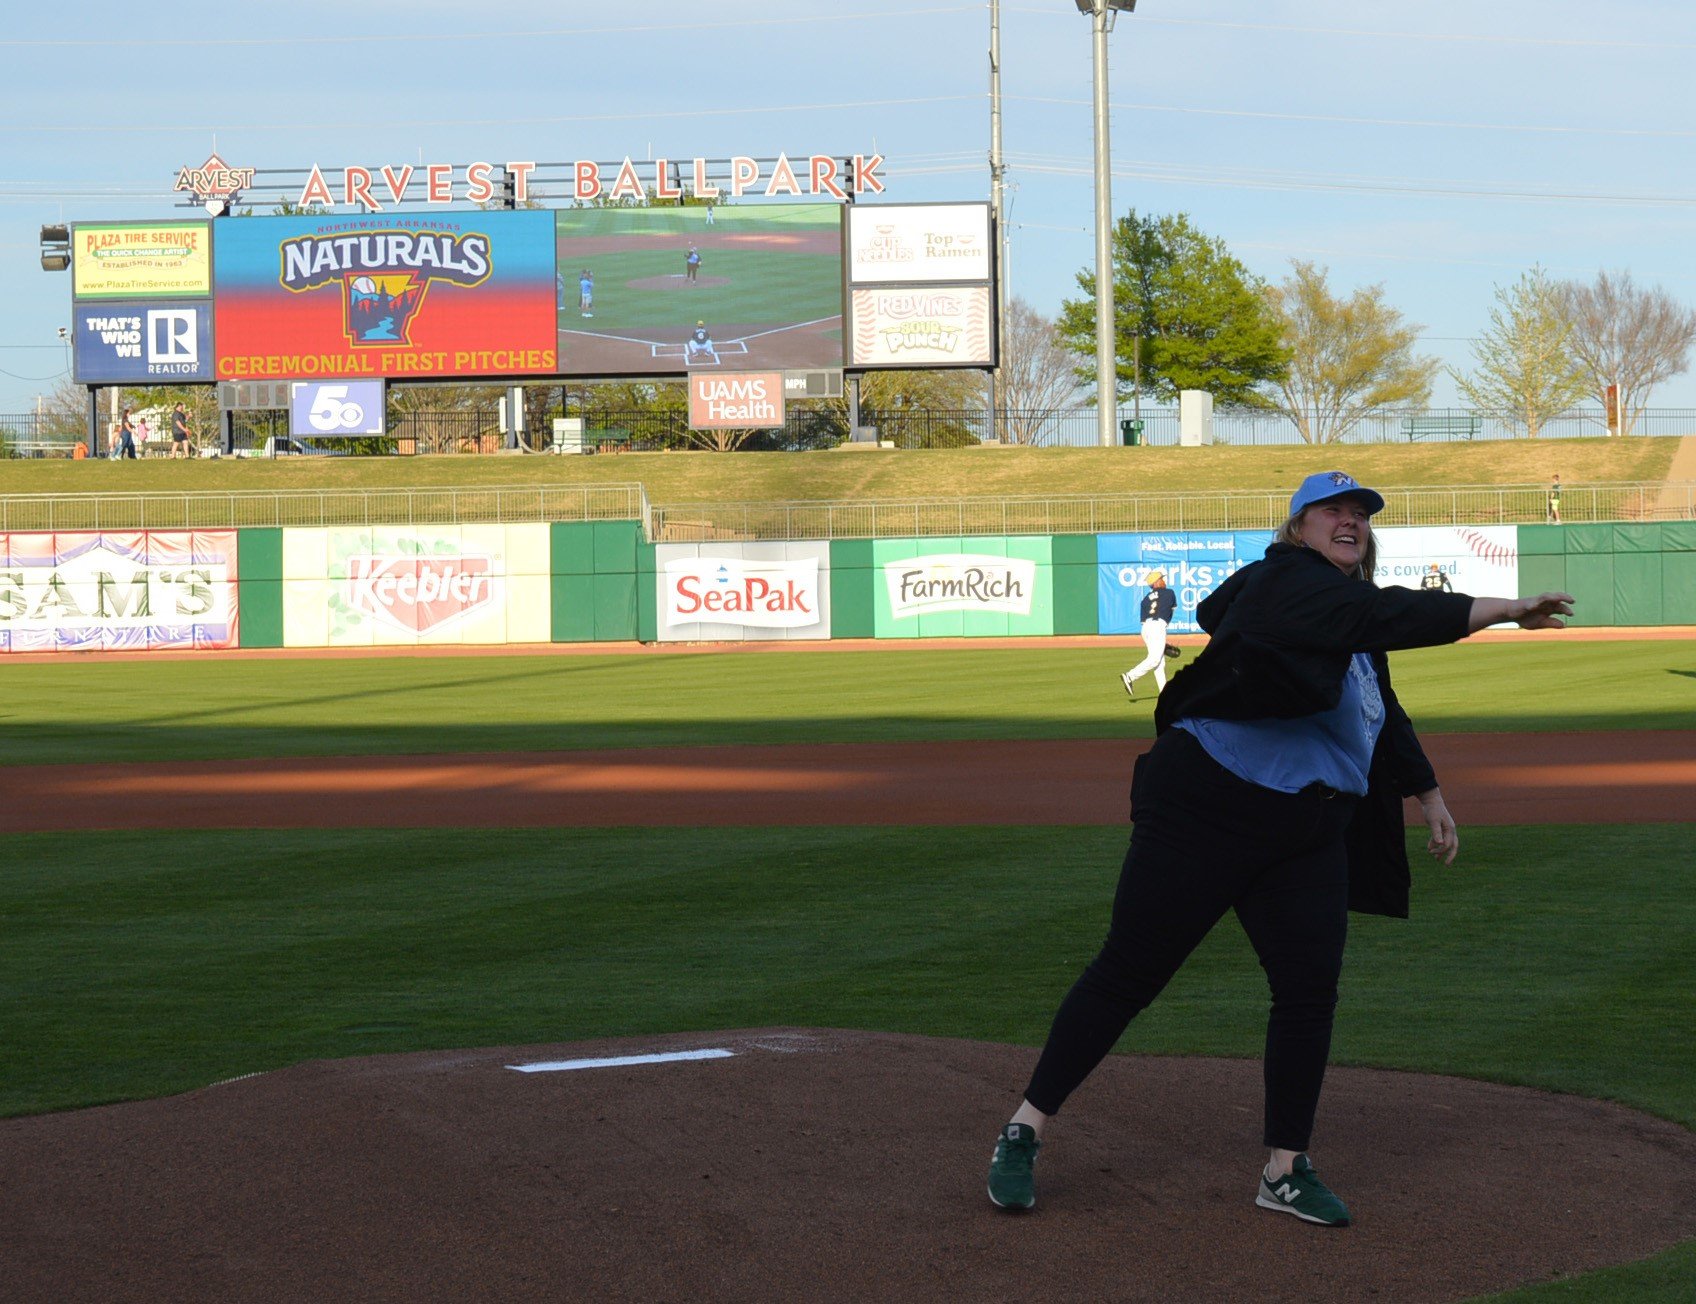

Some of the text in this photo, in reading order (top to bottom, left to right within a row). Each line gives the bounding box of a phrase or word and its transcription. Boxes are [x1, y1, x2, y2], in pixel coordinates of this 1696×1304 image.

[174, 167, 254, 192] ARVEST
[297, 151, 887, 211] ARVEST BALLPARK
[317, 220, 461, 233] NORTHWEST ARKANSAS
[87, 232, 198, 252] PLAZA TIRE SERVICE
[924, 233, 953, 247] Top
[285, 235, 487, 282] NATURALS
[926, 246, 981, 257] Ramen
[102, 259, 153, 269] ESTABLISHED
[82, 279, 203, 289] www.PlazaTireService.com
[86, 317, 141, 331] THAT'S
[901, 321, 941, 334] SOUR
[101, 331, 141, 344] WHO
[886, 331, 958, 353] PUNCH
[115, 345, 142, 357] WE
[218, 350, 556, 375] CEREMONIAL FIRST PITCHES
[699, 379, 767, 401] UAMS
[785, 378, 807, 390] MPH
[708, 400, 776, 420] Health
[1207, 540, 1235, 550] Local.
[1118, 560, 1213, 587] ozrks
[1394, 561, 1461, 576] coveed.
[351, 558, 490, 610] Keebler
[901, 568, 1023, 602] FarmRich
[1425, 576, 1442, 588] 25
[676, 575, 811, 614] SeaPak
